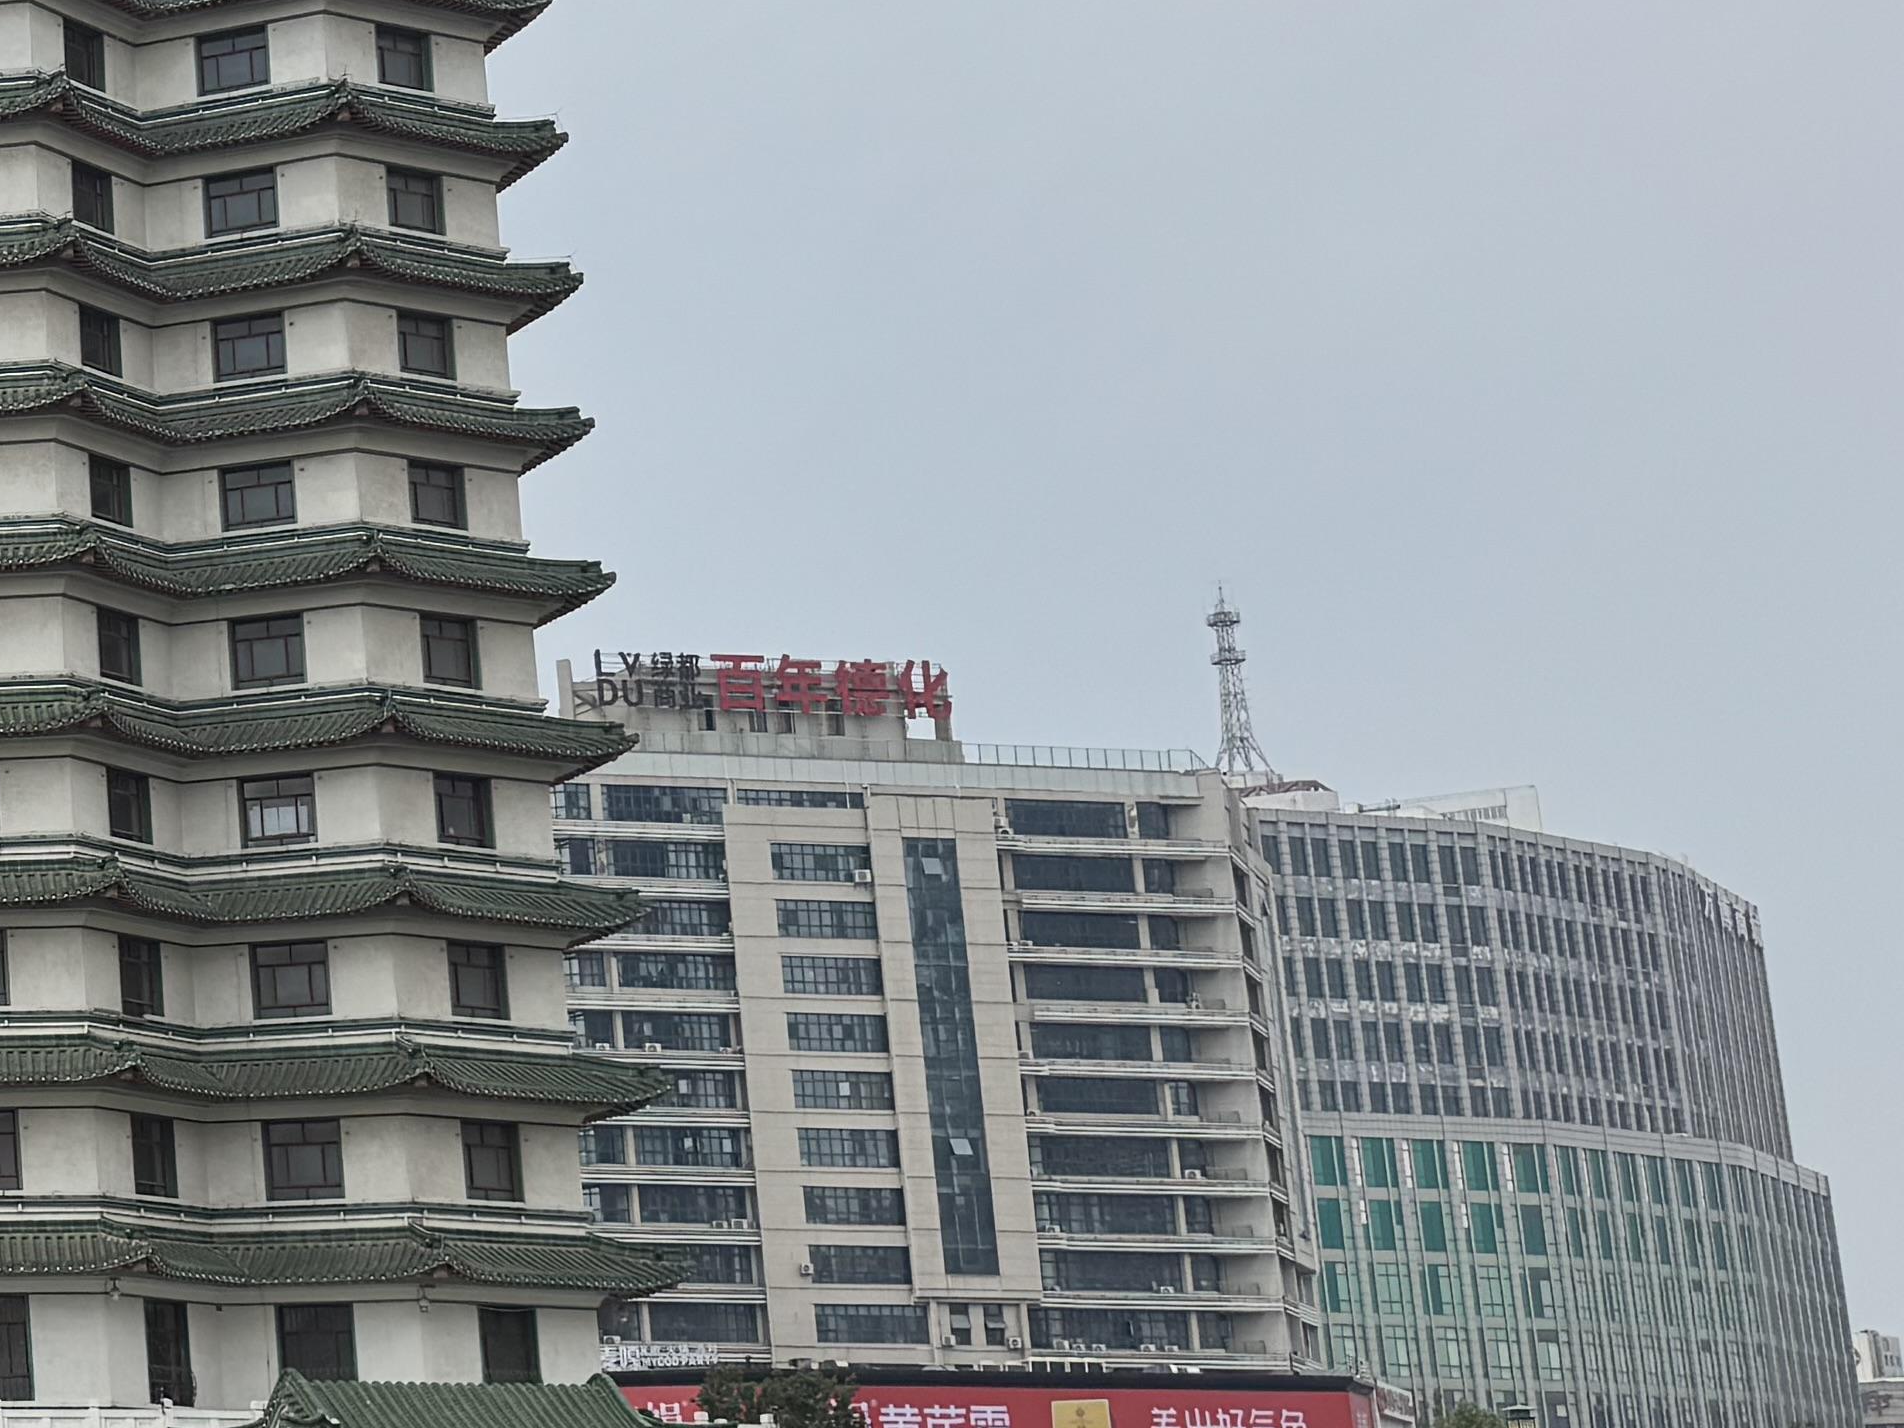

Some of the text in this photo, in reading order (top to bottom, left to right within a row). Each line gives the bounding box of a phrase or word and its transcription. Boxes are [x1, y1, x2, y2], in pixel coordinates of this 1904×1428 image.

[597, 678, 644, 708] DU
[710, 653, 953, 723] 百年德化
